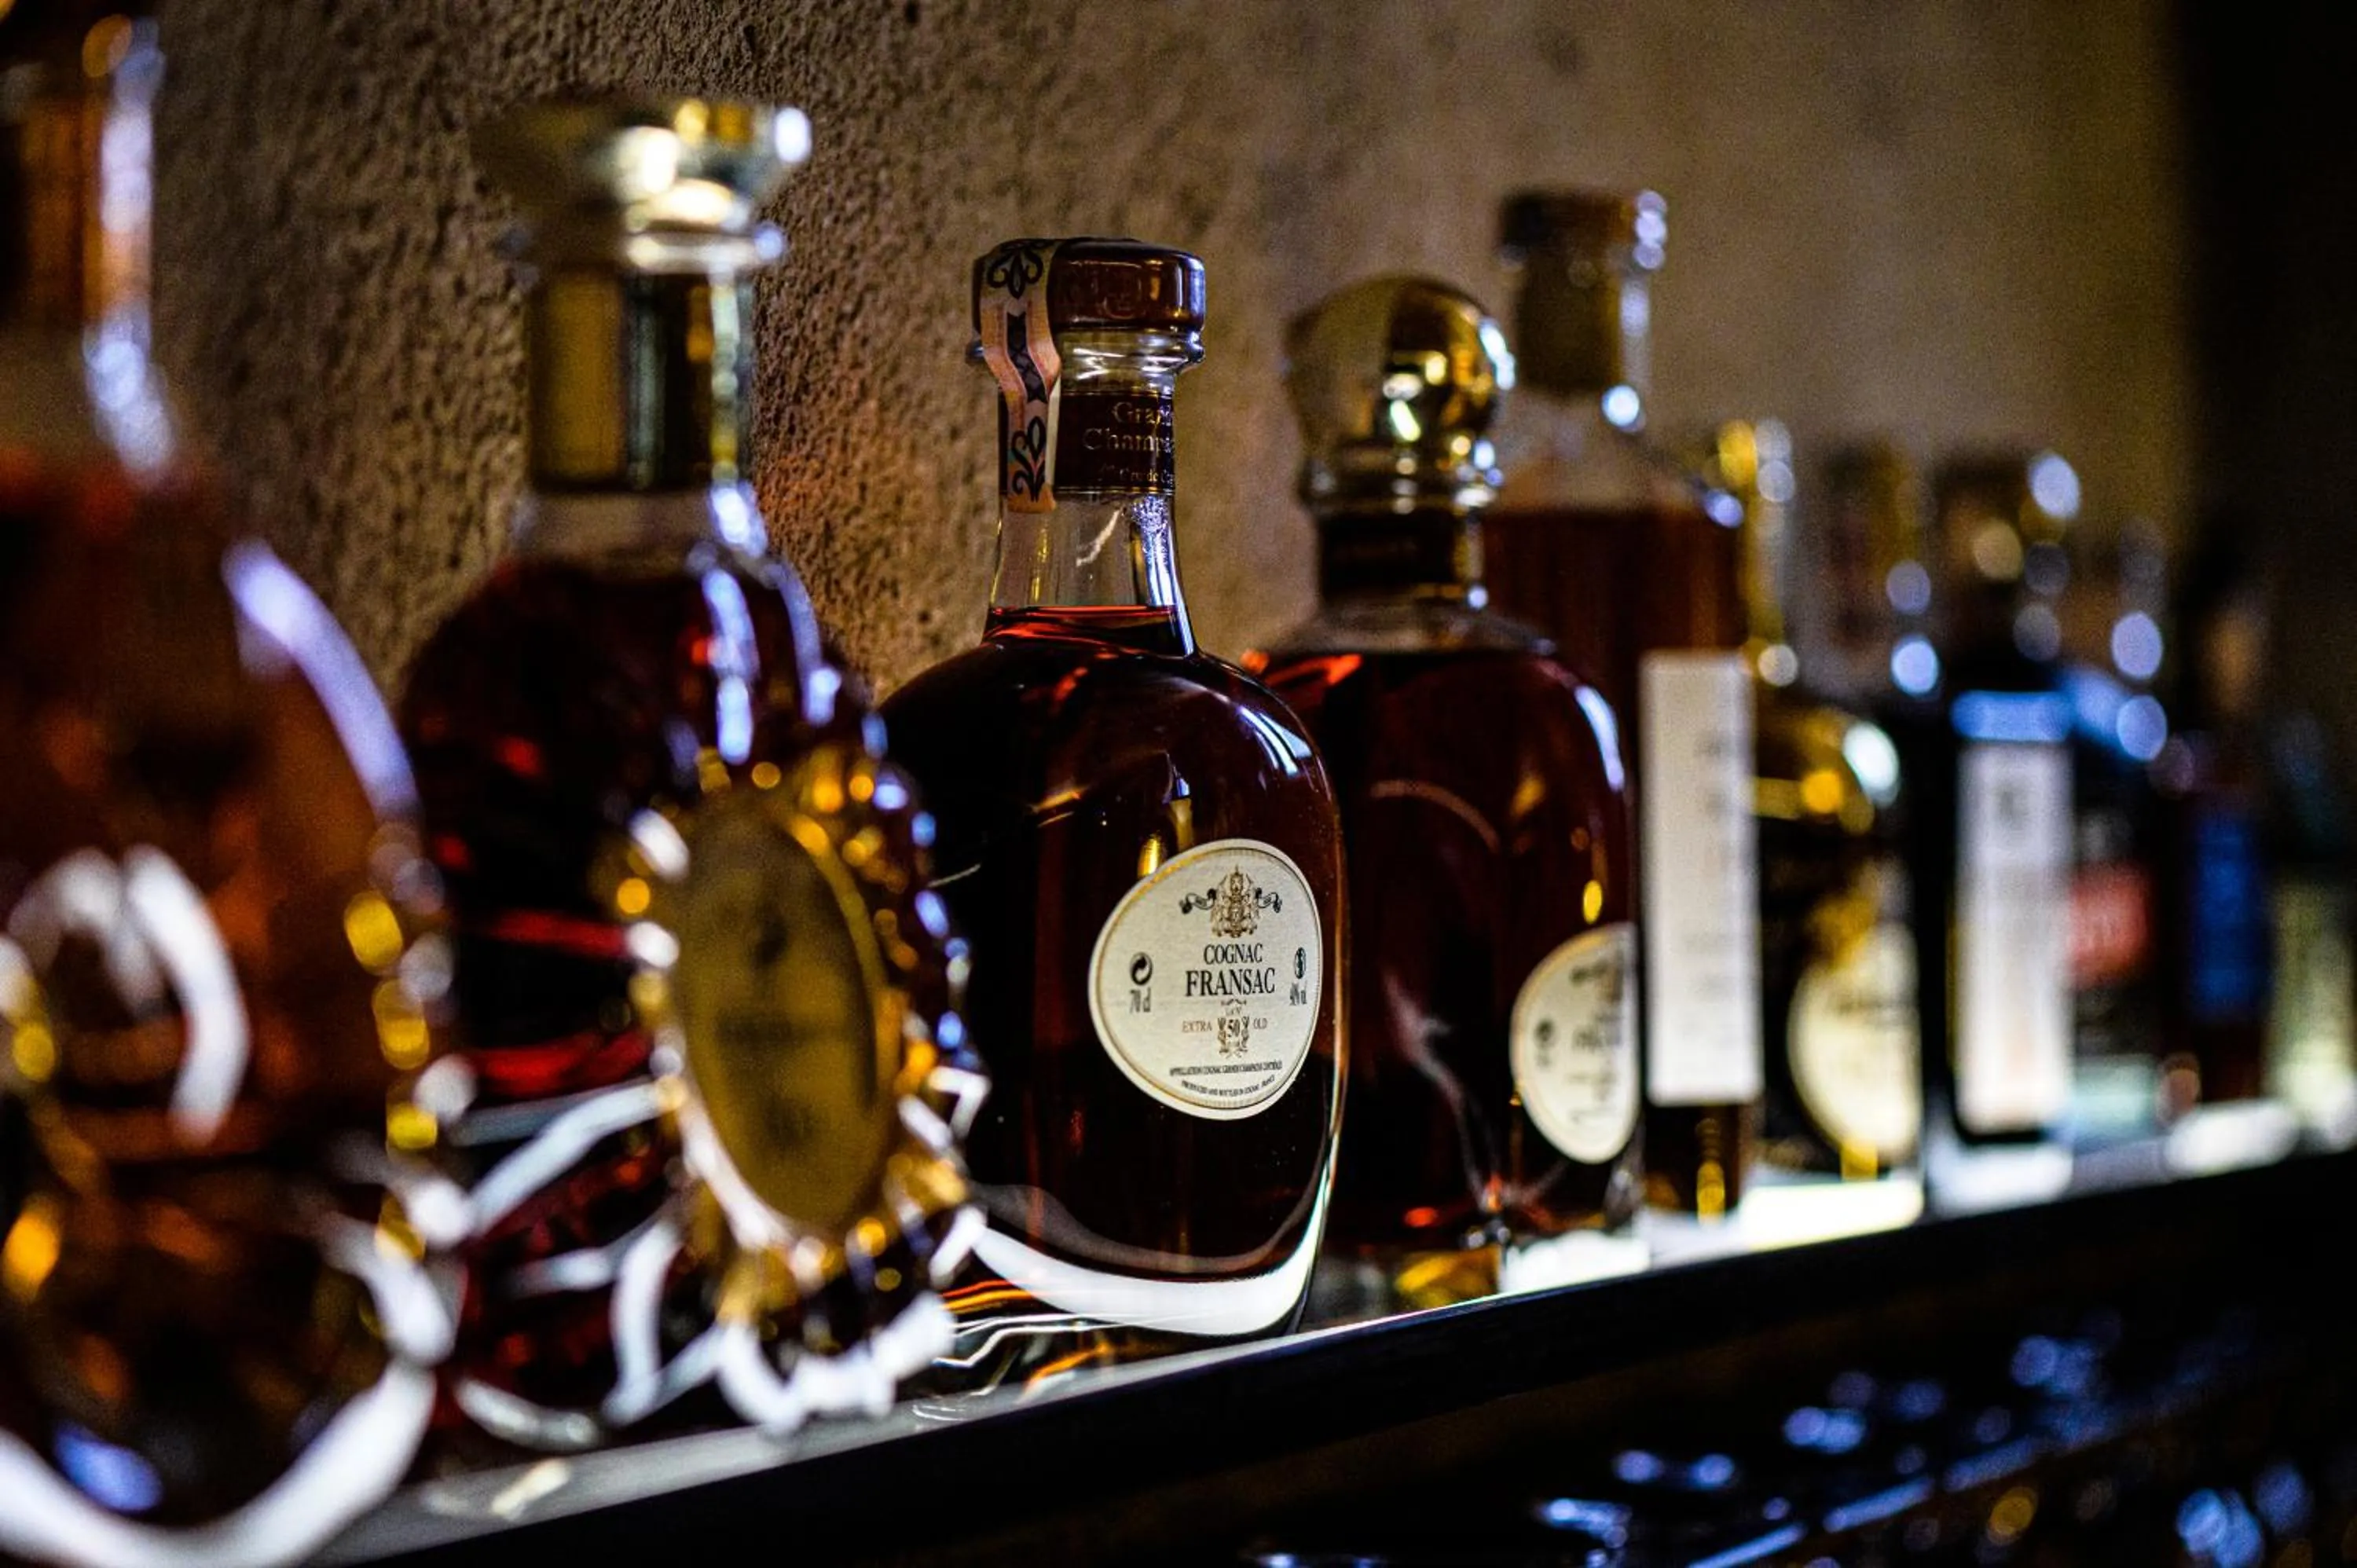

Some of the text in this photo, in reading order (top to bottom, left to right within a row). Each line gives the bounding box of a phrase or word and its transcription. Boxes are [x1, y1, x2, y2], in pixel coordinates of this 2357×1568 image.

[1204, 943, 1263, 965] COGNAC
[1186, 967, 1275, 996] FRANSAC
[1182, 1020, 1212, 1032] EXTRA
[1252, 1017, 1266, 1029] OLD
